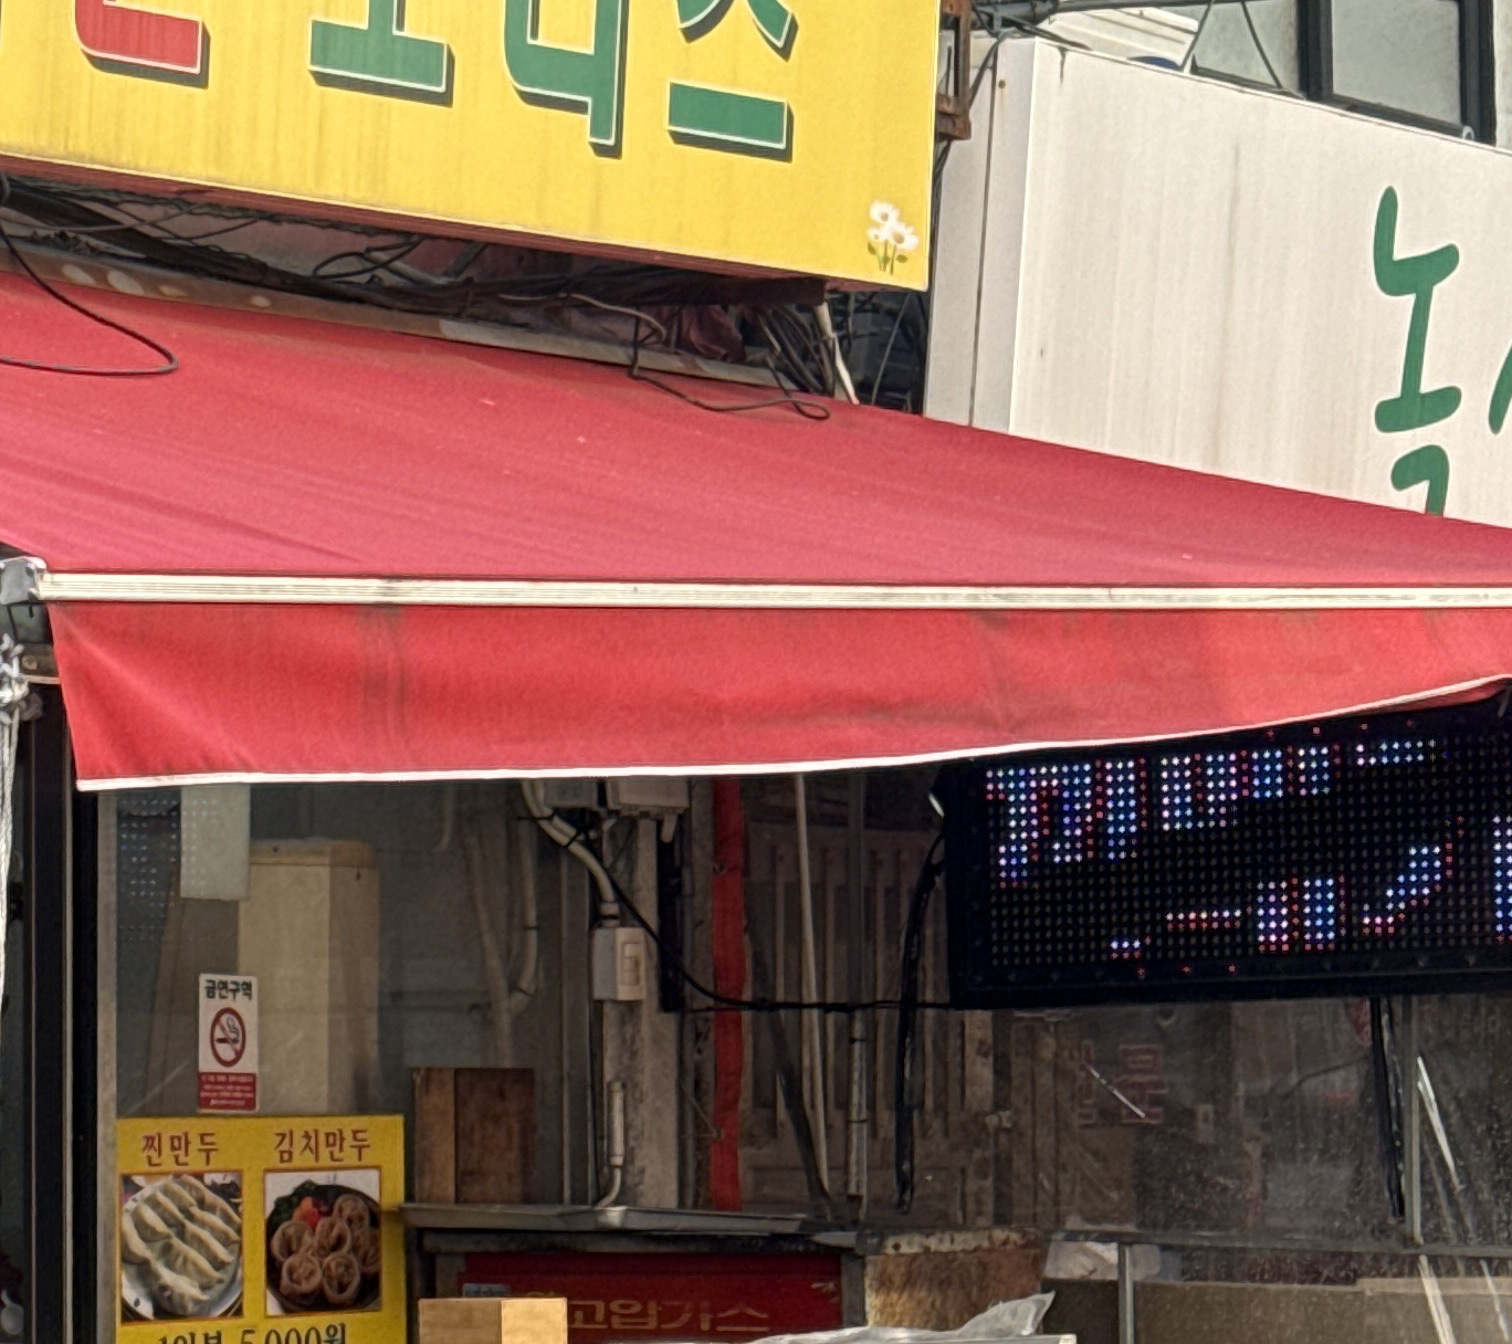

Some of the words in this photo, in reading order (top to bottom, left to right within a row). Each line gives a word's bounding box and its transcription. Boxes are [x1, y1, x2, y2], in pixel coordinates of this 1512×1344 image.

[204, 978, 253, 1001] 금연구역
[141, 1131, 221, 1168] 찐만두
[273, 1128, 372, 1164] 김치만두
